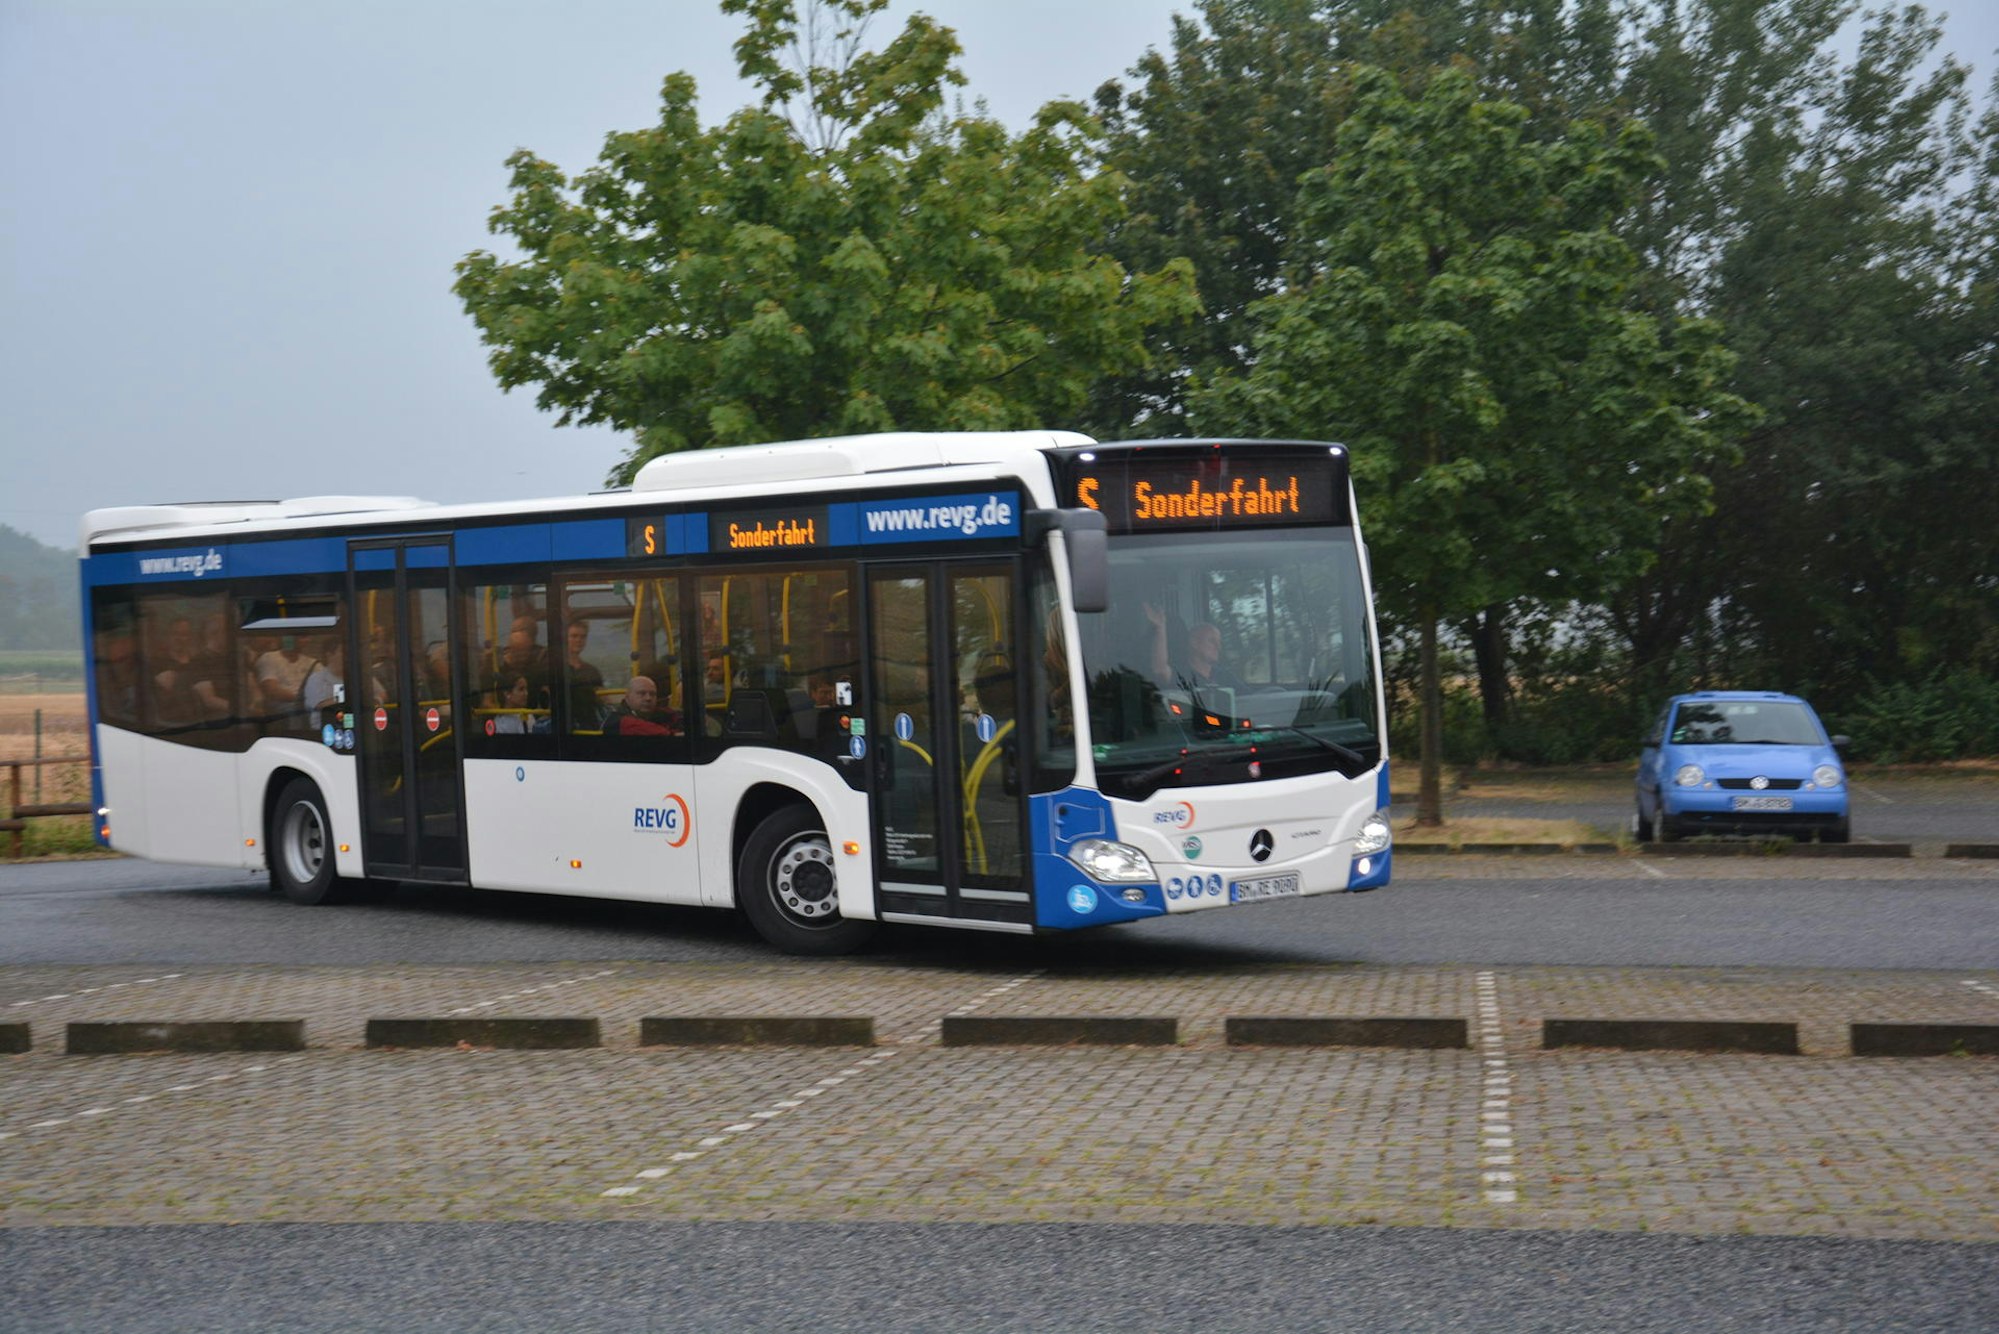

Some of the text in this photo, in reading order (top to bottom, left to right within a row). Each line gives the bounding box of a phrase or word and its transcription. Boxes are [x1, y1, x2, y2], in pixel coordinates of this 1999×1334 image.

[1135, 476, 1300, 519] Sonderfahrt
[866, 495, 1012, 535] www.revg.de
[645, 518, 815, 555] S Sonderfahrt
[139, 548, 223, 577] www.revg.de
[634, 807, 677, 829] REVG
[1153, 810, 1186, 824] REVG
